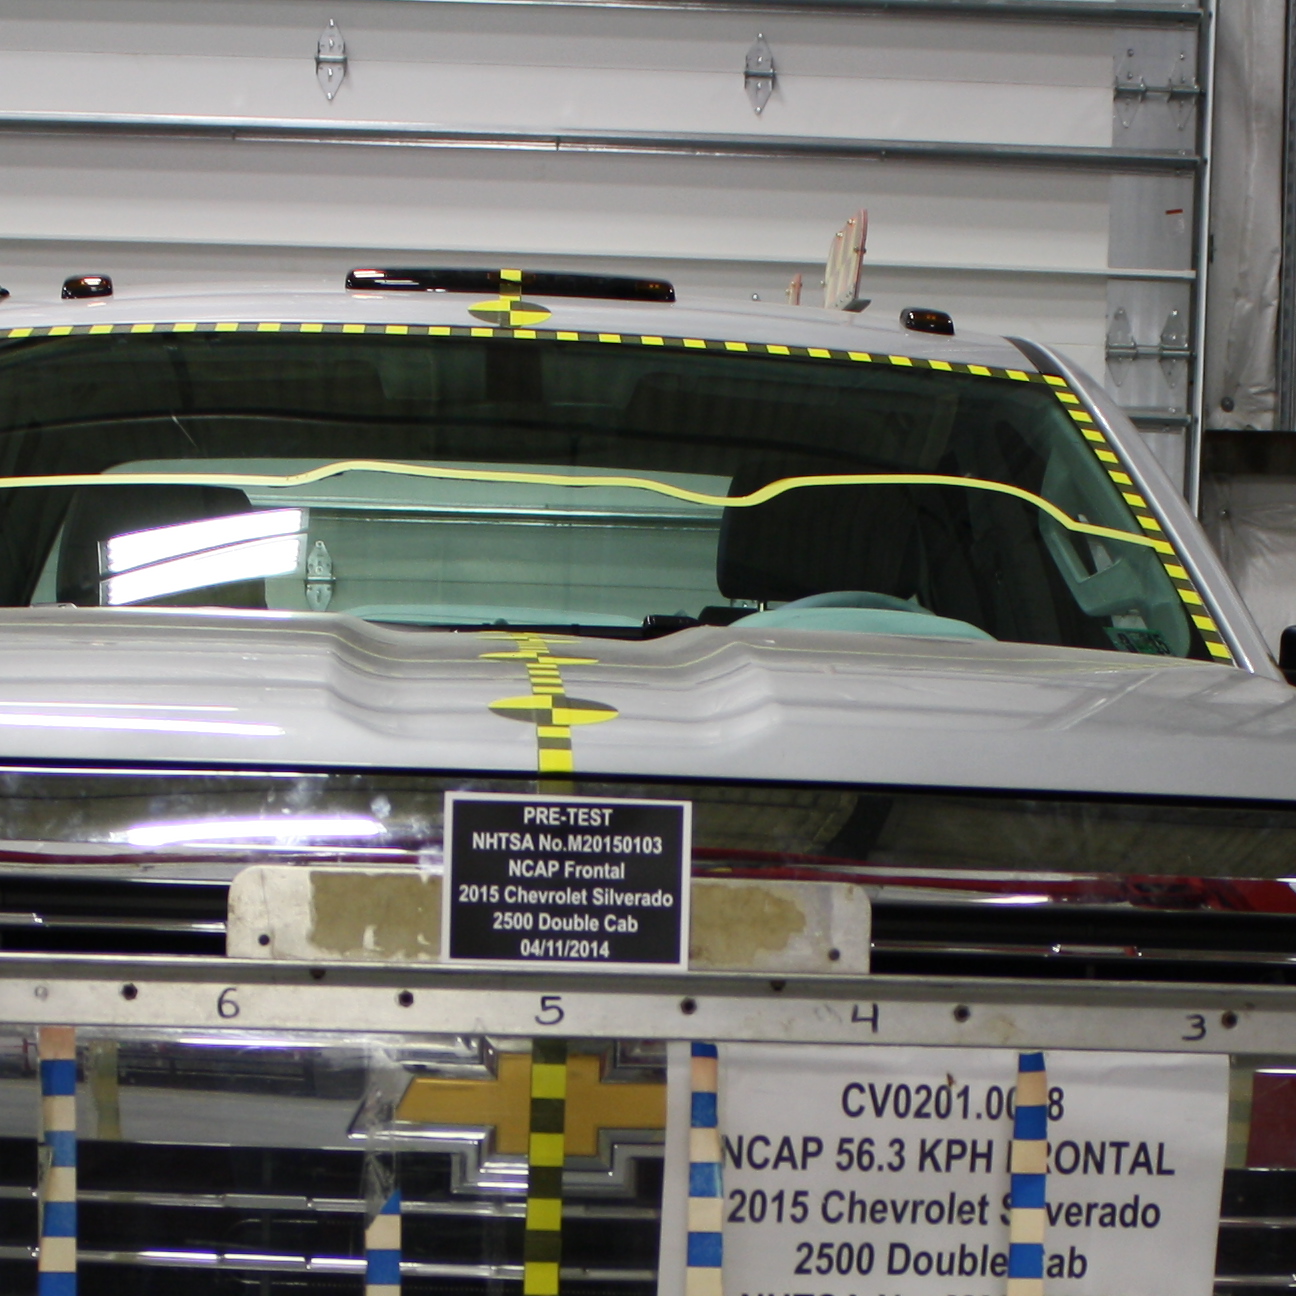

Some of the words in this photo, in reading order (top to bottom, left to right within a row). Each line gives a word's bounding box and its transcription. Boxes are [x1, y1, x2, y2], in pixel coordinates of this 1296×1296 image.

[523, 806, 613, 826] PRE-TEST
[472, 832, 534, 851] NHTSA
[538, 834, 663, 854] No.M20150103
[508, 859, 560, 877] NCAP
[564, 861, 625, 879] Frontal
[458, 885, 500, 902] 2015
[504, 886, 588, 905] Chevrolet
[592, 888, 674, 907] Silverado
[493, 912, 533, 930] 2500
[538, 913, 599, 932] Double
[604, 914, 639, 933] Cab
[520, 939, 610, 958] 04/11/2014
[216, 986, 242, 1020] 6
[534, 995, 566, 1027] 5
[850, 1003, 880, 1034] 4
[1182, 1014, 1208, 1043] 3
[722, 1134, 824, 1171] NCAP
[835, 1137, 906, 1173] 56.3
[918, 1138, 994, 1174] KPH
[726, 1188, 810, 1224] 2015
[820, 1189, 990, 1227] Chevrolet
[794, 1242, 875, 1276] 2500
[887, 1243, 1009, 1278] Double
